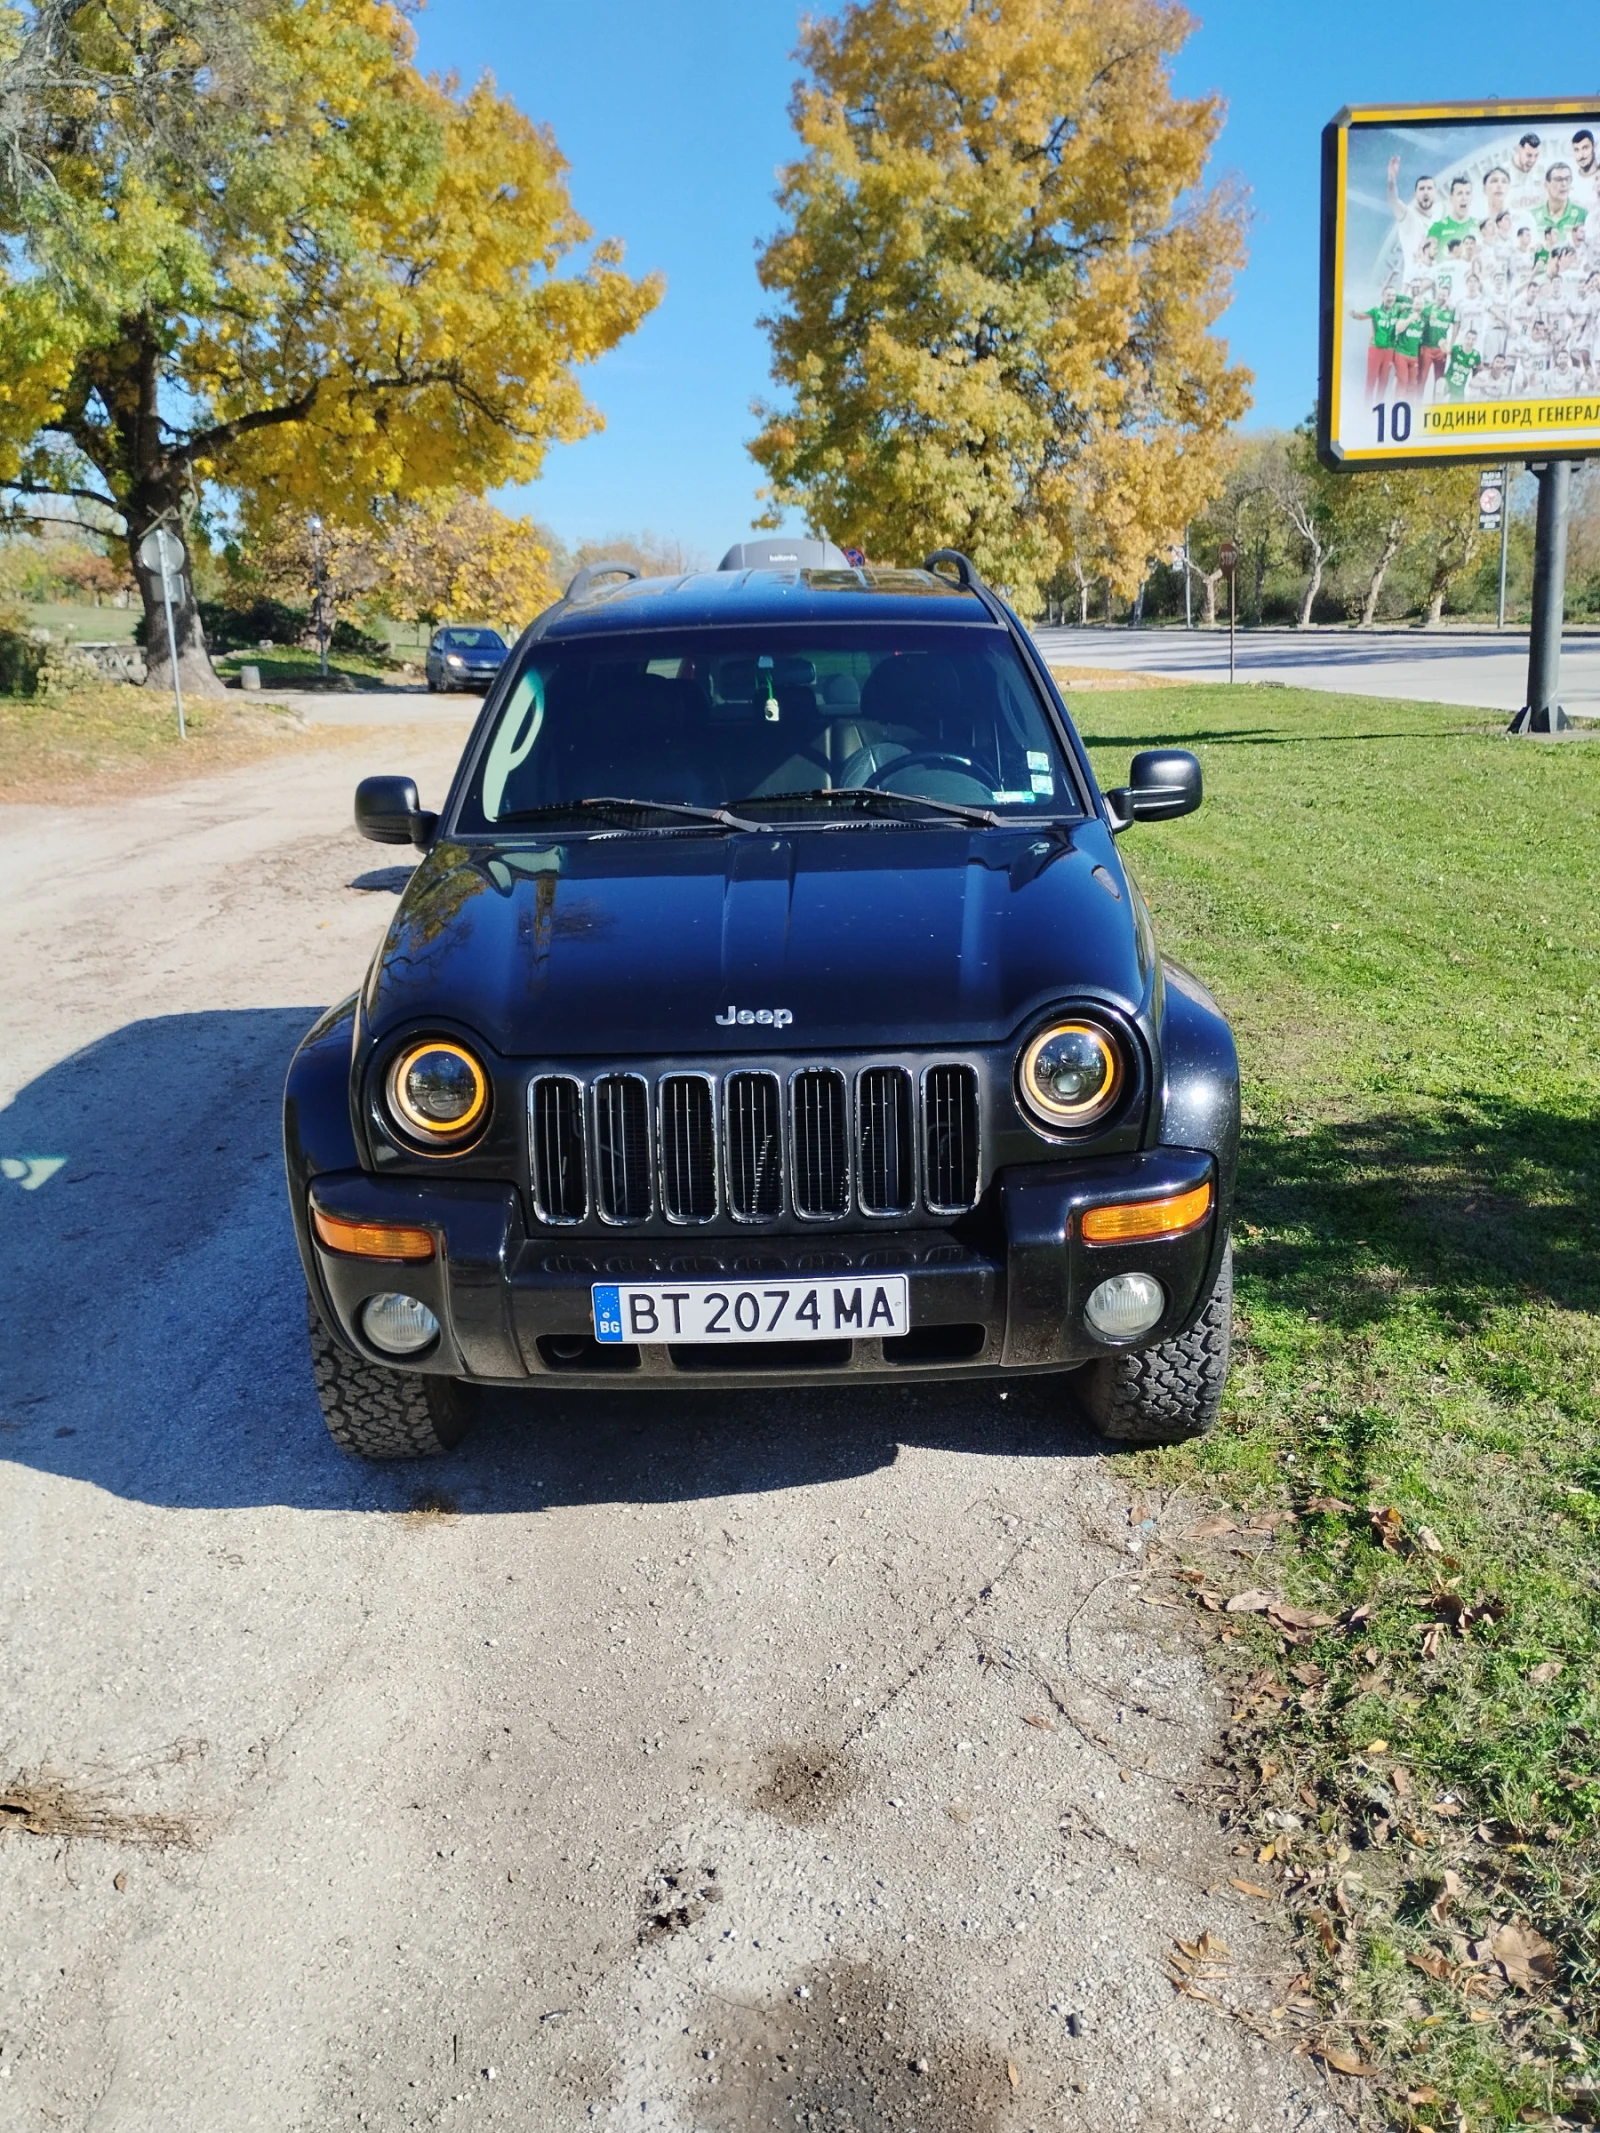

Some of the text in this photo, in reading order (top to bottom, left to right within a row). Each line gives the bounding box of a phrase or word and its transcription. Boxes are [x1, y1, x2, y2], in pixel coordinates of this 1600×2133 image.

[1371, 401, 1411, 443] 10
[1423, 409, 1486, 429] ГОДИНИ
[1492, 407, 1532, 427] ГОРД
[715, 1005, 793, 1028] Jeep
[599, 1320, 621, 1334] BG
[703, 1289, 822, 1334] 2074
[833, 1286, 895, 1330] MA
